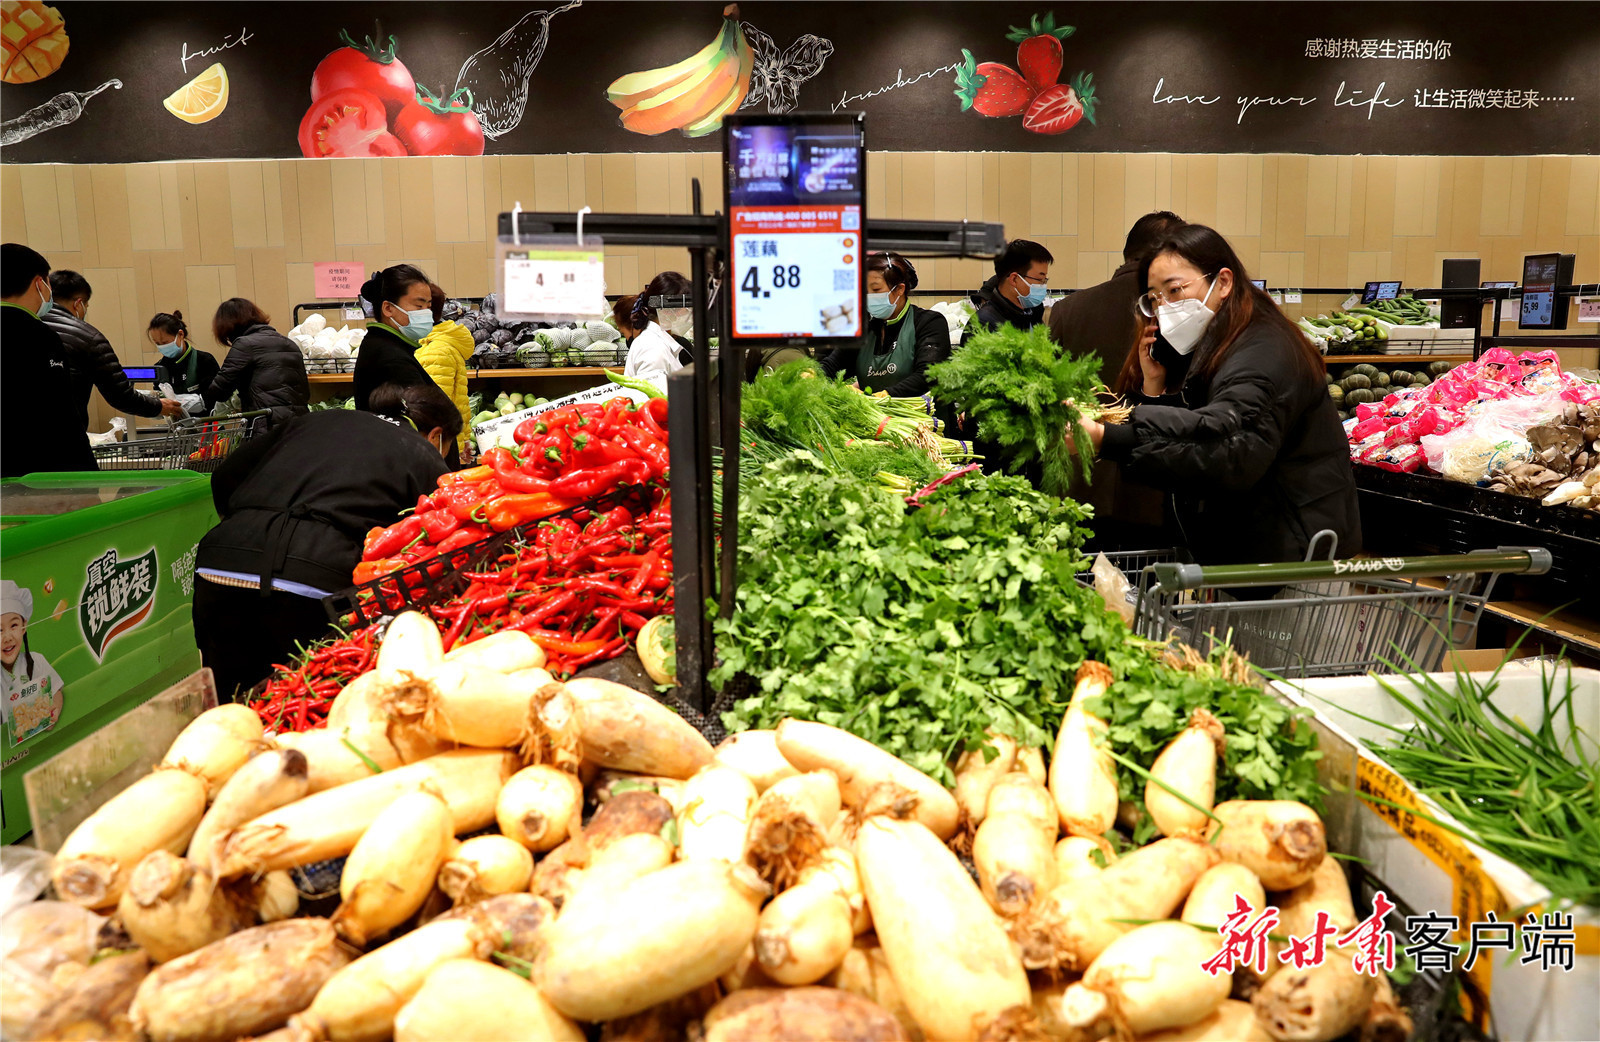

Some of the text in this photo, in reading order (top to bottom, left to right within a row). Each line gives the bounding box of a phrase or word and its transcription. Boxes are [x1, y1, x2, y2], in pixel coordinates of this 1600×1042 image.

[181, 27, 254, 73] fruit
[1304, 38, 1452, 61] 感谢热爱生活的你
[1152, 77, 1221, 106] love
[1237, 95, 1317, 125] your
[1334, 81, 1405, 121] life
[743, 239, 779, 258] 莲藕
[740, 264, 801, 299] 4.88
[1523, 301, 1539, 314] 5.99
[867, 365, 887, 377] Bravo
[88, 552, 117, 592] 真空
[1332, 559, 1383, 575] Bravo
[86, 558, 153, 638] 锁鲜装
